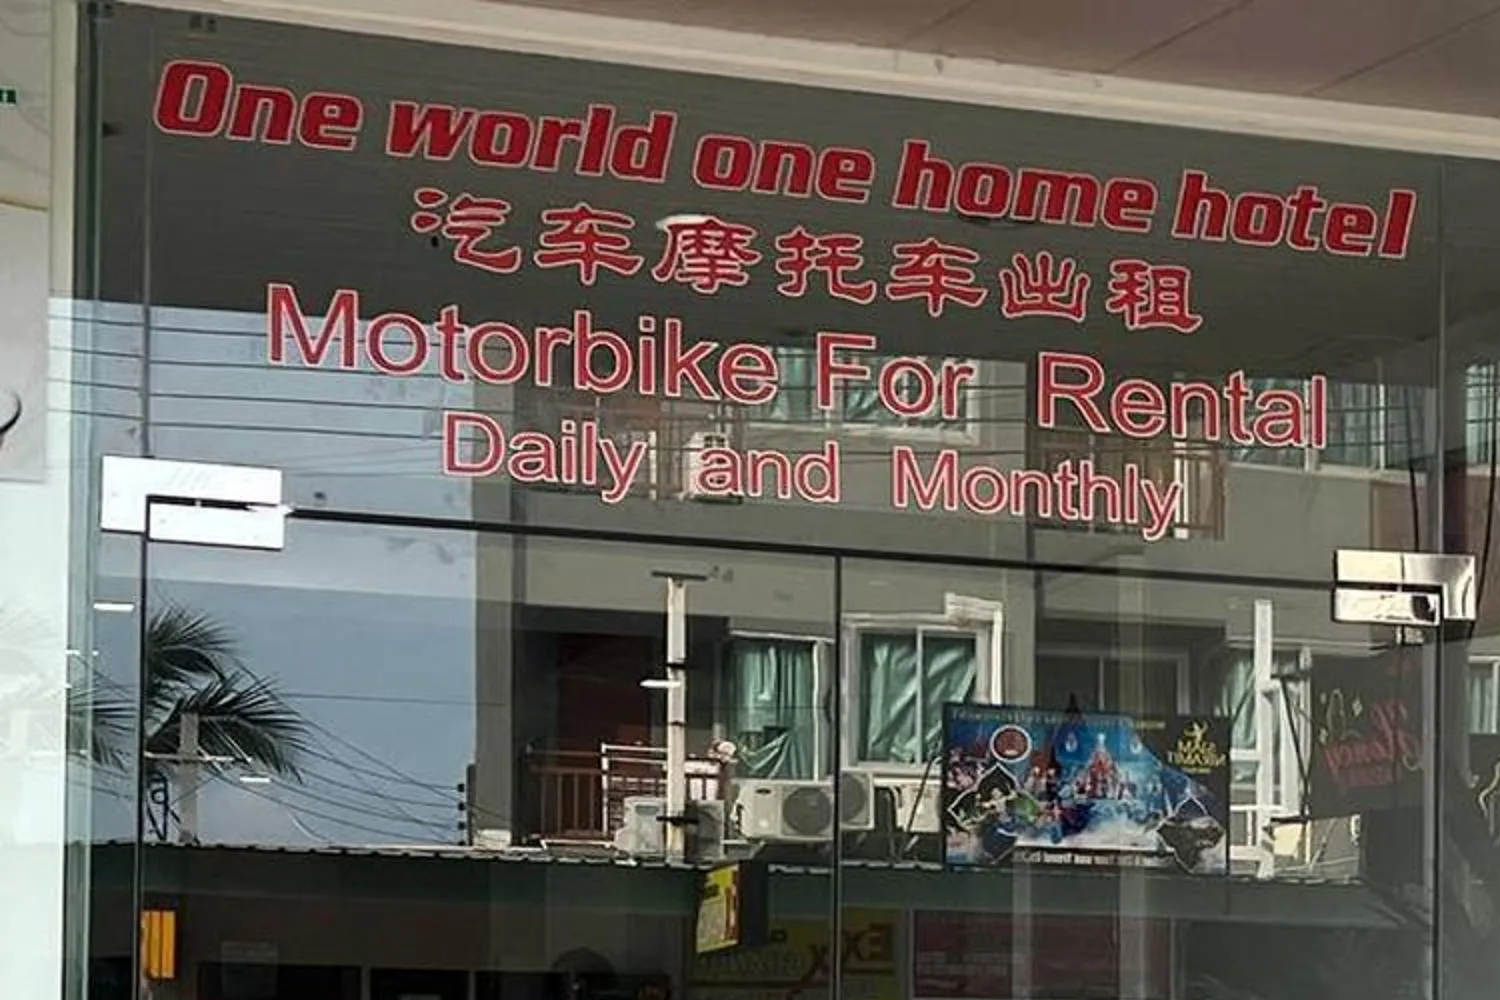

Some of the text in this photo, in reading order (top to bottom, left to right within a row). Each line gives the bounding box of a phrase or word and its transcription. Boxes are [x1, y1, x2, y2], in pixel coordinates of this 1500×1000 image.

[154, 58, 1416, 259] One world one home hotel
[410, 187, 1203, 333] 汽车摩托车出租
[265, 283, 1326, 449] Motorbike For Rental
[441, 412, 1182, 541] Daily and Monthly
